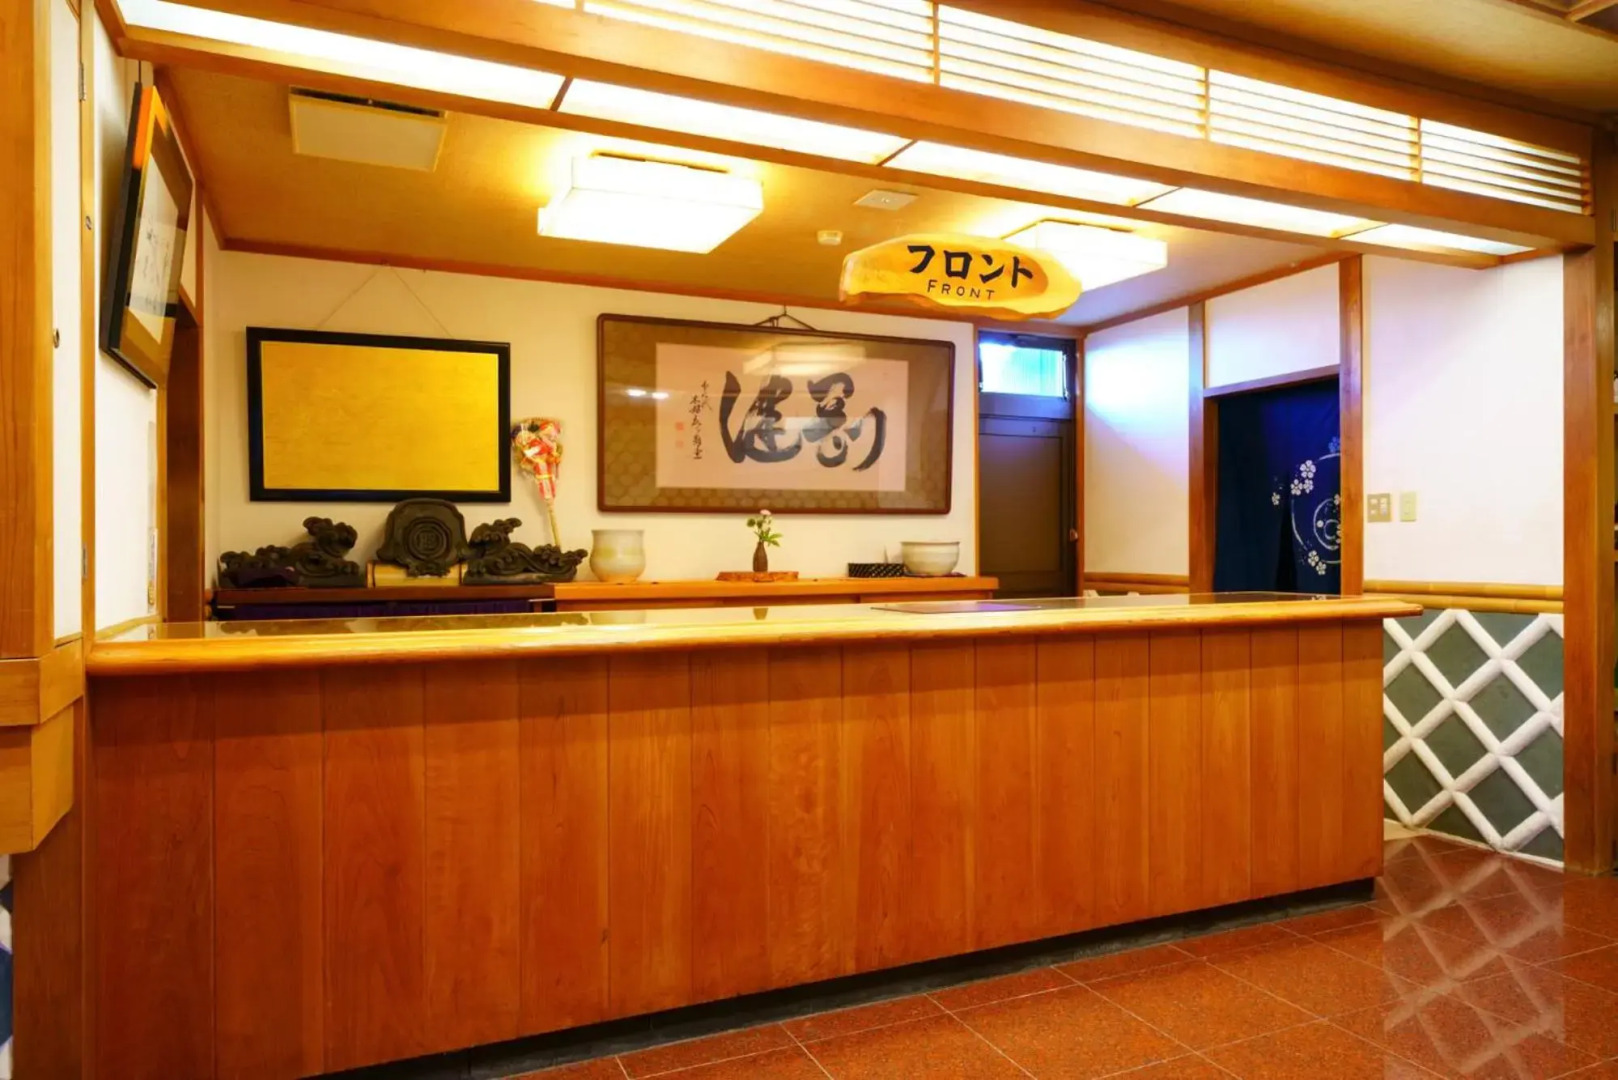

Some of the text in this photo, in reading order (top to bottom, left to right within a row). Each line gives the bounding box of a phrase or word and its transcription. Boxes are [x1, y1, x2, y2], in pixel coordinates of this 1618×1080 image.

[907, 245, 1033, 288] フロント
[927, 279, 995, 300] FRONT
